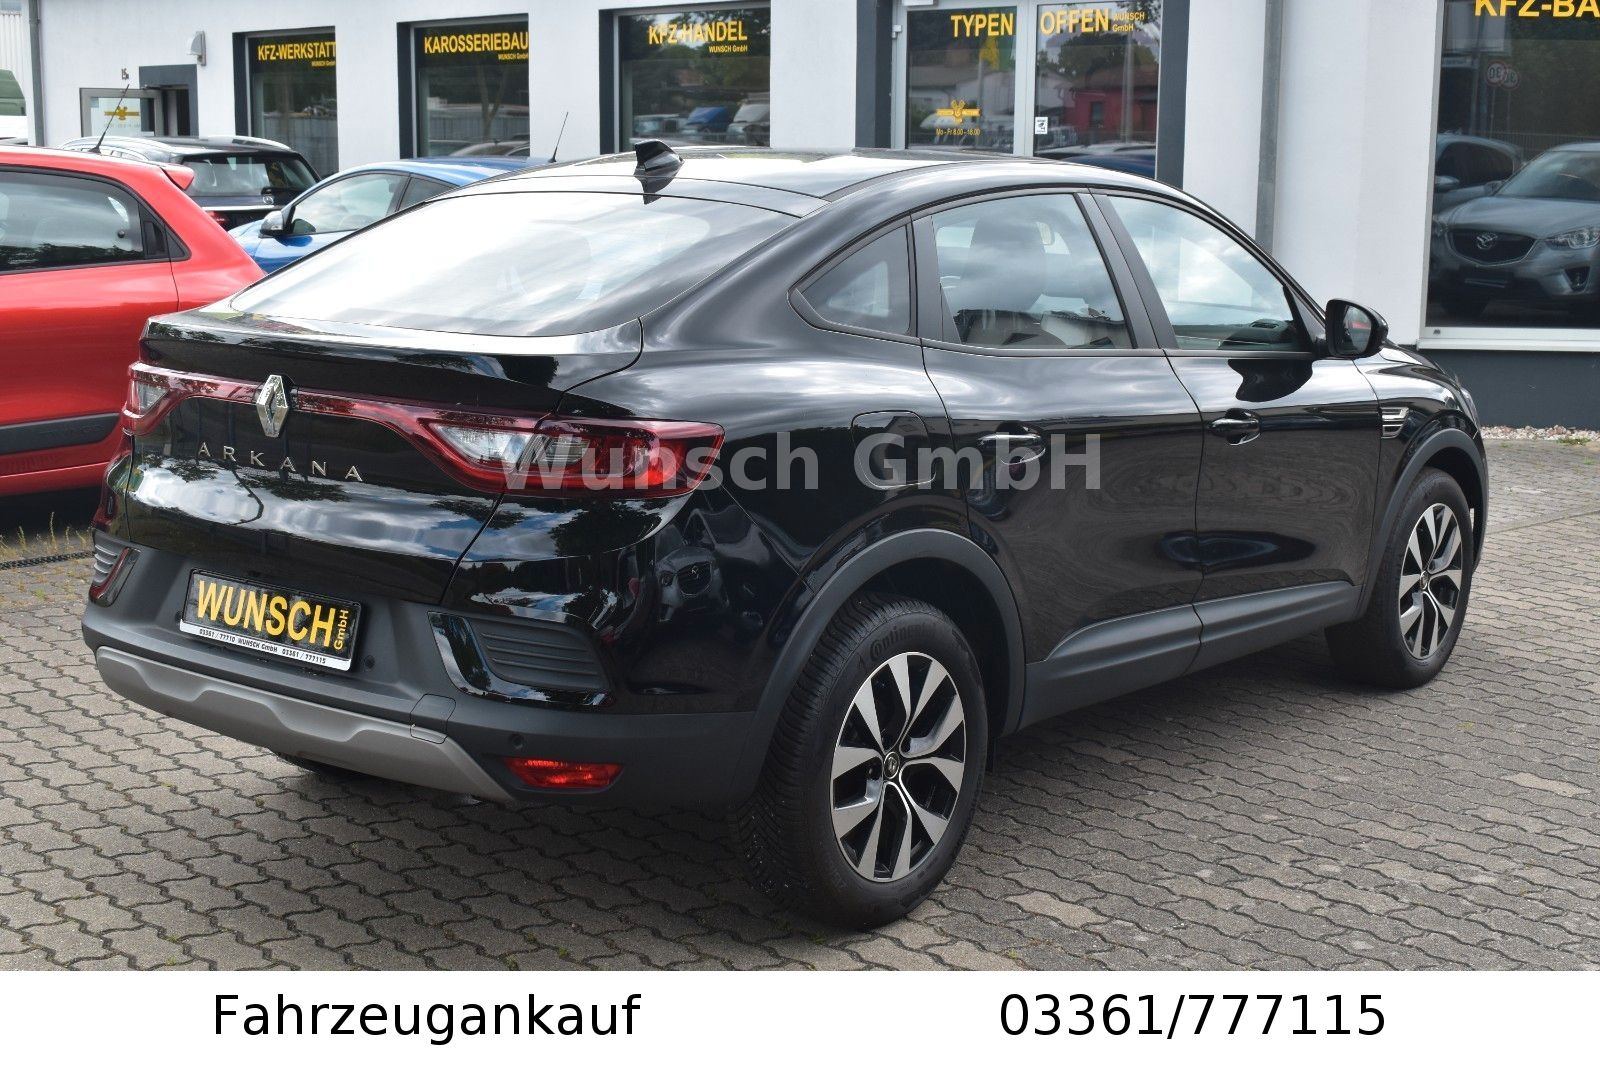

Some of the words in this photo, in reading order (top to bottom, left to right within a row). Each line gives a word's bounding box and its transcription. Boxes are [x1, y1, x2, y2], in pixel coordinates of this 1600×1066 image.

[950, 13, 1014, 37] TYPEN
[1040, 8, 1109, 35] OFFEN
[1113, 12, 1145, 21] WUNSCH
[648, 21, 748, 44] KFZ-HANDEL
[1112, 24, 1134, 32] GmbH
[258, 42, 336, 60] KFZ-WERKSTATT
[424, 32, 529, 53] KAROSSERIEBAU
[198, 441, 363, 482] ARKANA
[197, 580, 336, 647] WUNSCH
[333, 609, 349, 650] GmbH
[238, 637, 260, 648] WUNSCH
[261, 643, 278, 652] GmbH
